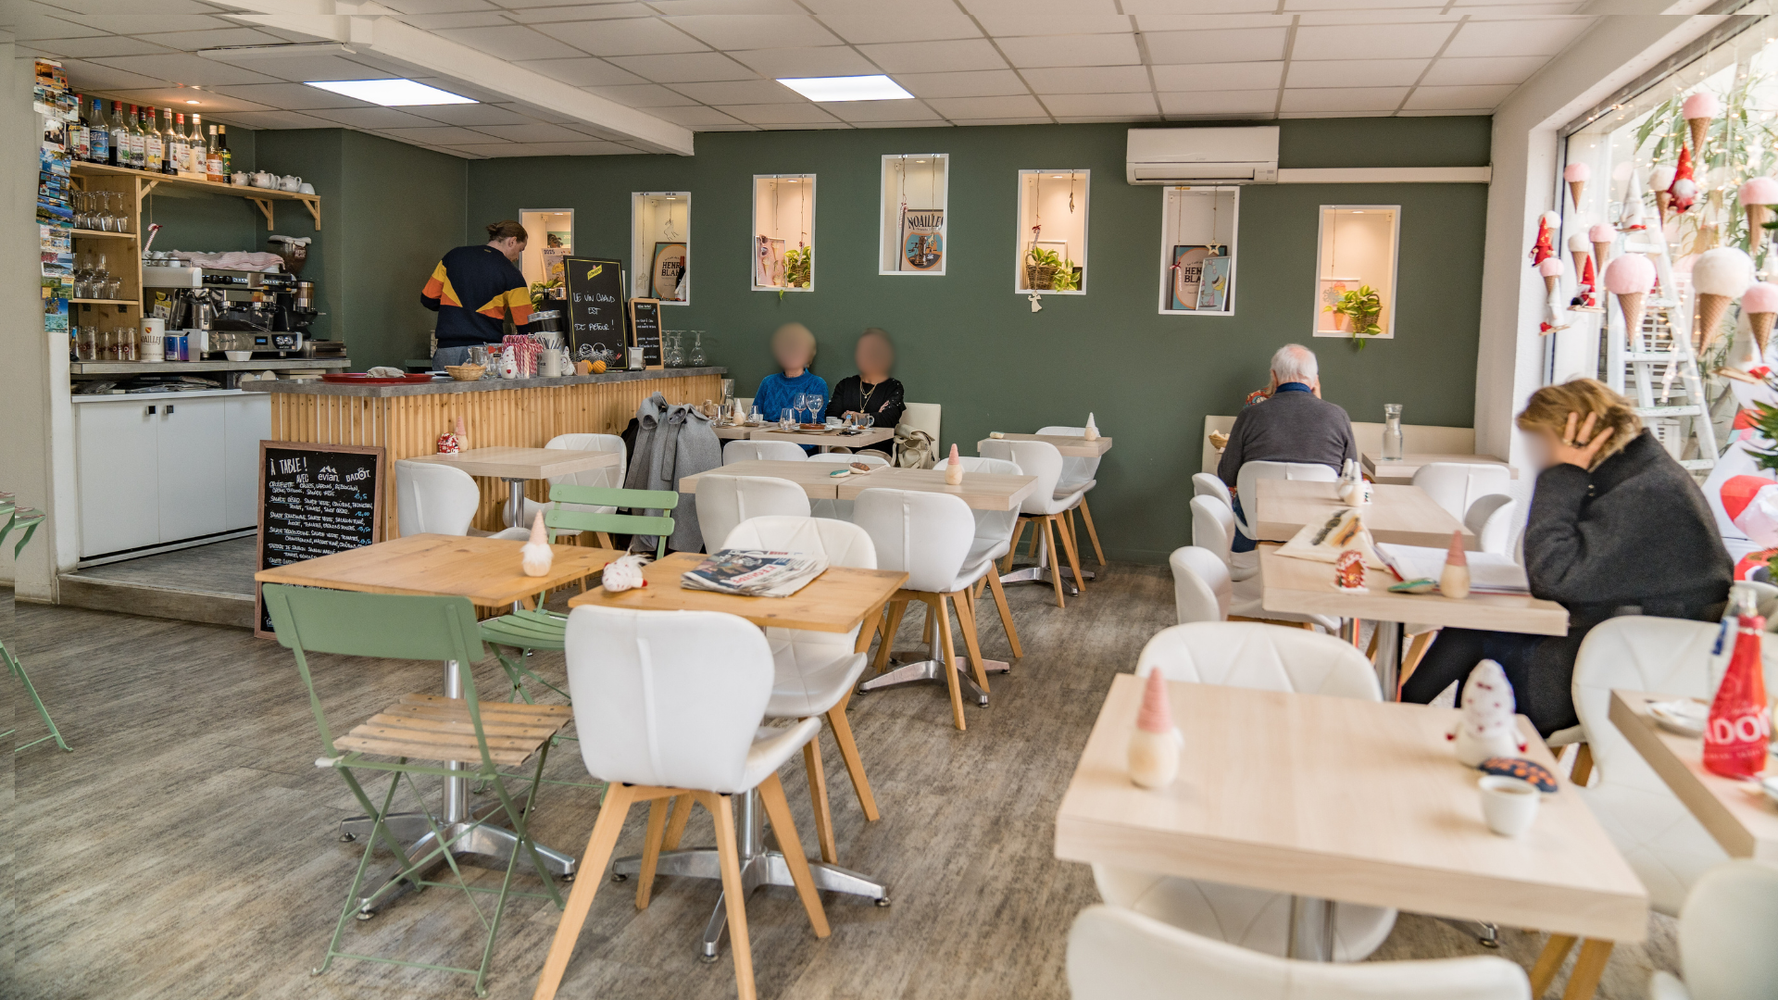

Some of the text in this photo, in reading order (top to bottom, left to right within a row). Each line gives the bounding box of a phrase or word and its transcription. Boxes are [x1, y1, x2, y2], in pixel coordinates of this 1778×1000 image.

[1184, 267, 1202, 275] HEN
[1184, 275, 1201, 283] BLA
[279, 457, 302, 475] TABLE
[296, 474, 309, 484] AVEC
[317, 473, 339, 482] evian
